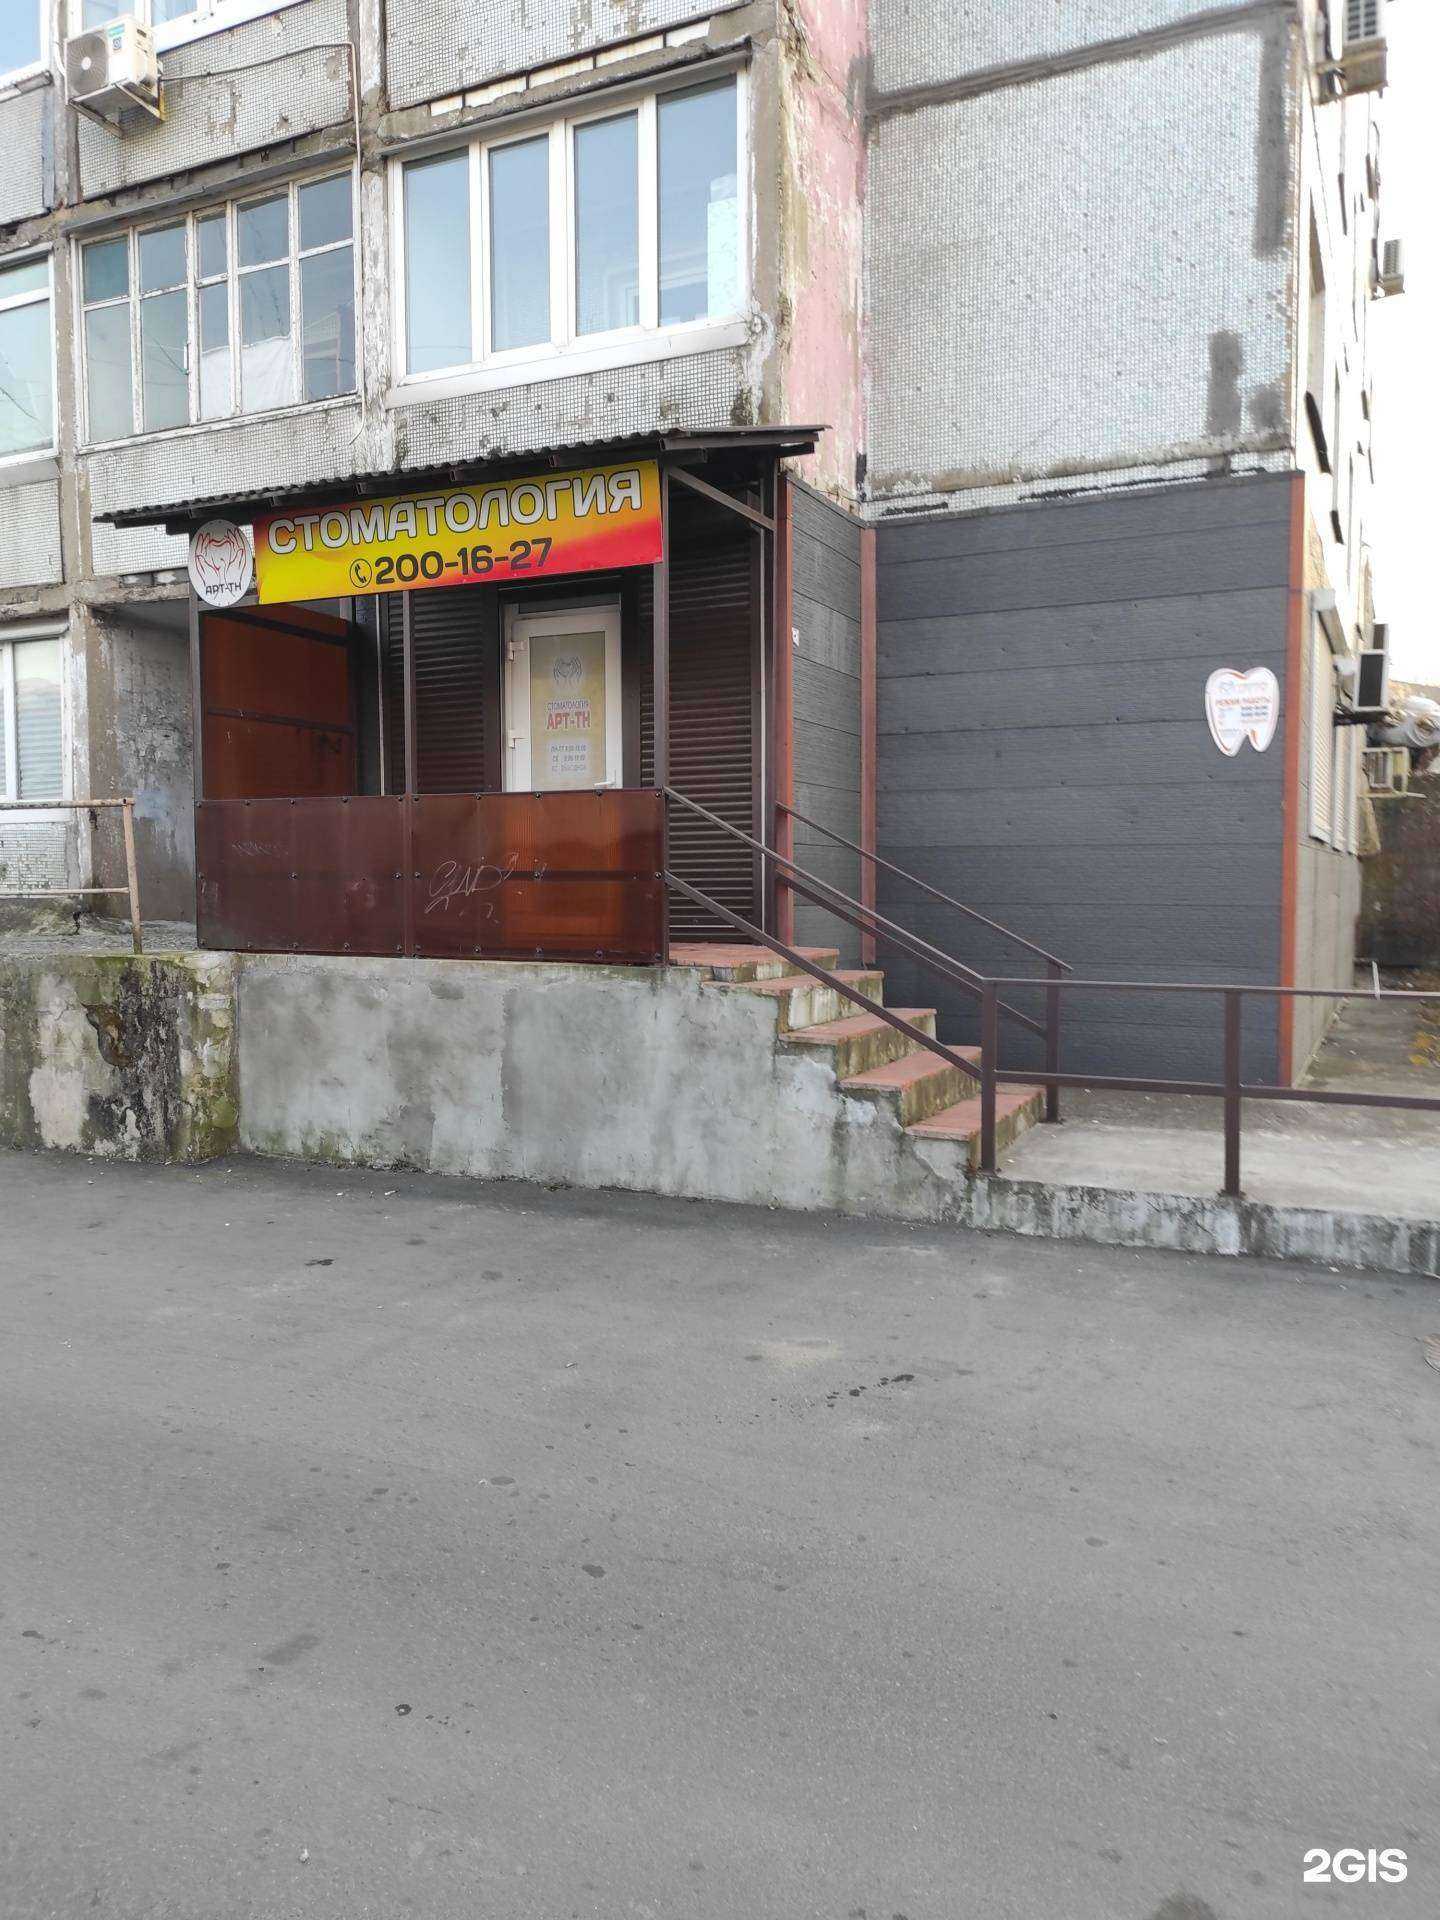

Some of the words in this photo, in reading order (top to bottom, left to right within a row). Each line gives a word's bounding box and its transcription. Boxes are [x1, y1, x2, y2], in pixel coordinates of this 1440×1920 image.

[268, 469, 642, 554] СТОМАТОЛОГИЯ
[374, 537, 553, 585] 200-16-27
[546, 711, 591, 730] АРТ-ТН
